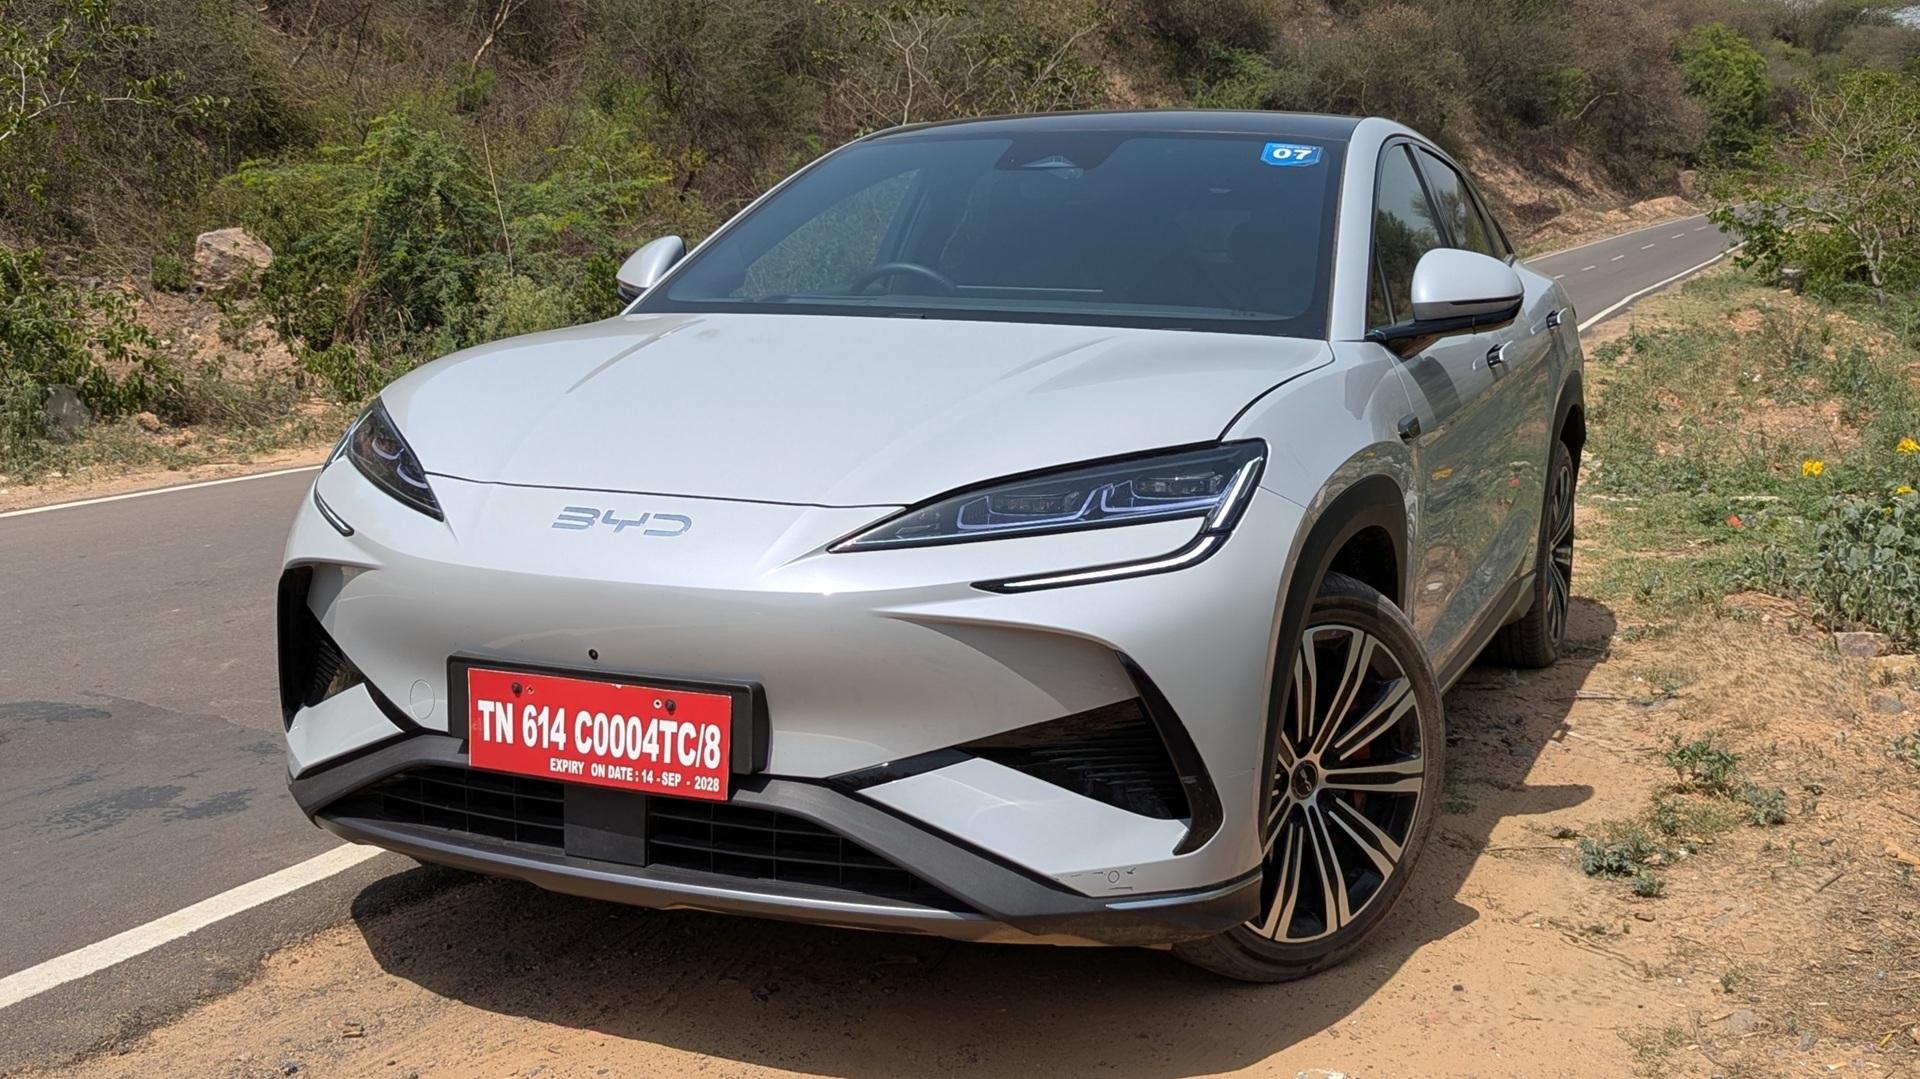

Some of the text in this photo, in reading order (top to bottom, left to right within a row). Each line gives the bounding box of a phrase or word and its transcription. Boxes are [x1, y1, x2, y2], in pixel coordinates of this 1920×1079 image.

[1272, 148, 1313, 160] 07
[551, 506, 692, 537] BYD
[477, 699, 721, 769] TN 614 C0004TC/8
[550, 758, 585, 775] EXPIRY
[591, 763, 606, 778] ON
[641, 769, 654, 784] 14
[694, 775, 720, 792] 2028
